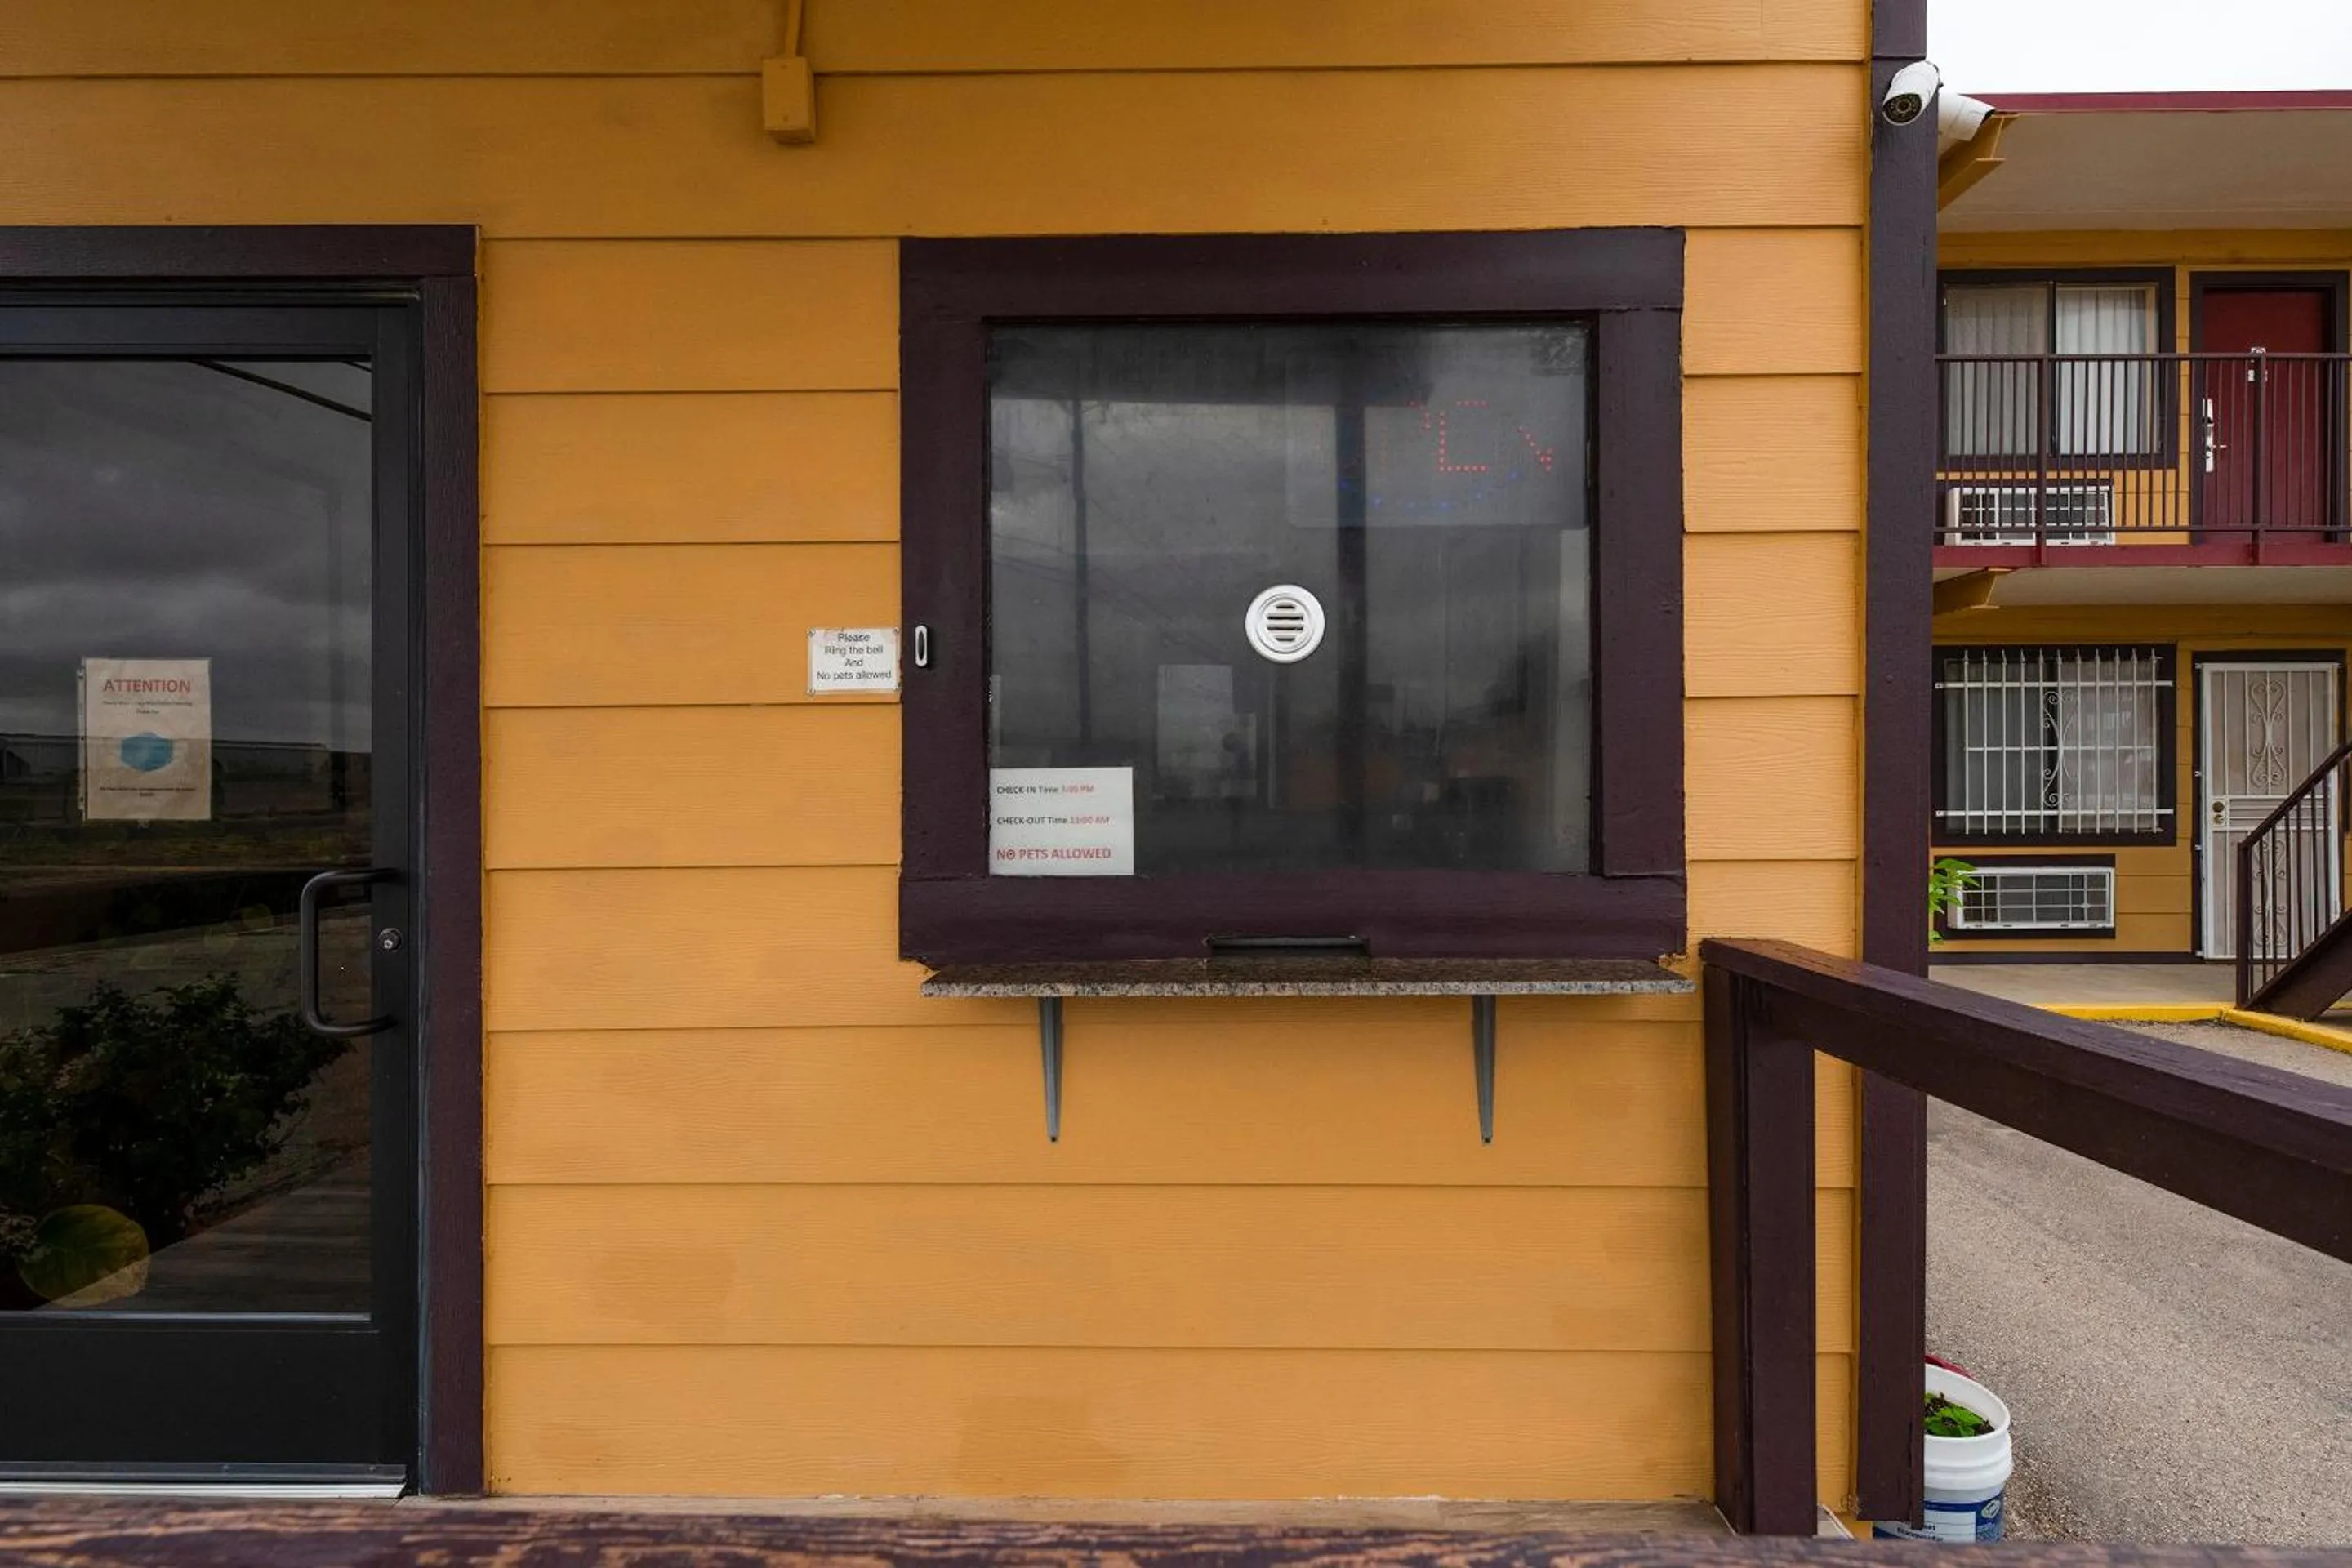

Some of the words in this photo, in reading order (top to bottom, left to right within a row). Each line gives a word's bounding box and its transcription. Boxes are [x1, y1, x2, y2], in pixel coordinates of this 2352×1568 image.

[838, 633, 871, 642] Please
[825, 645, 846, 657] Ring
[849, 645, 864, 654] the
[866, 645, 884, 654] bell
[844, 658, 863, 667] And
[817, 671, 831, 680] No
[833, 671, 853, 681] pets
[856, 670, 892, 679] allowed
[103, 679, 191, 693] ATTENTION
[996, 786, 1036, 795] CHECK-IN
[1039, 786, 1059, 794] Time
[1080, 785, 1095, 793] PM
[996, 817, 1047, 825] CHECK-OUT
[1048, 816, 1068, 825] Time
[1095, 816, 1111, 825] AM
[996, 849, 1016, 860] NO
[1019, 849, 1049, 859] PETS
[1051, 848, 1111, 859] ALLOWED
